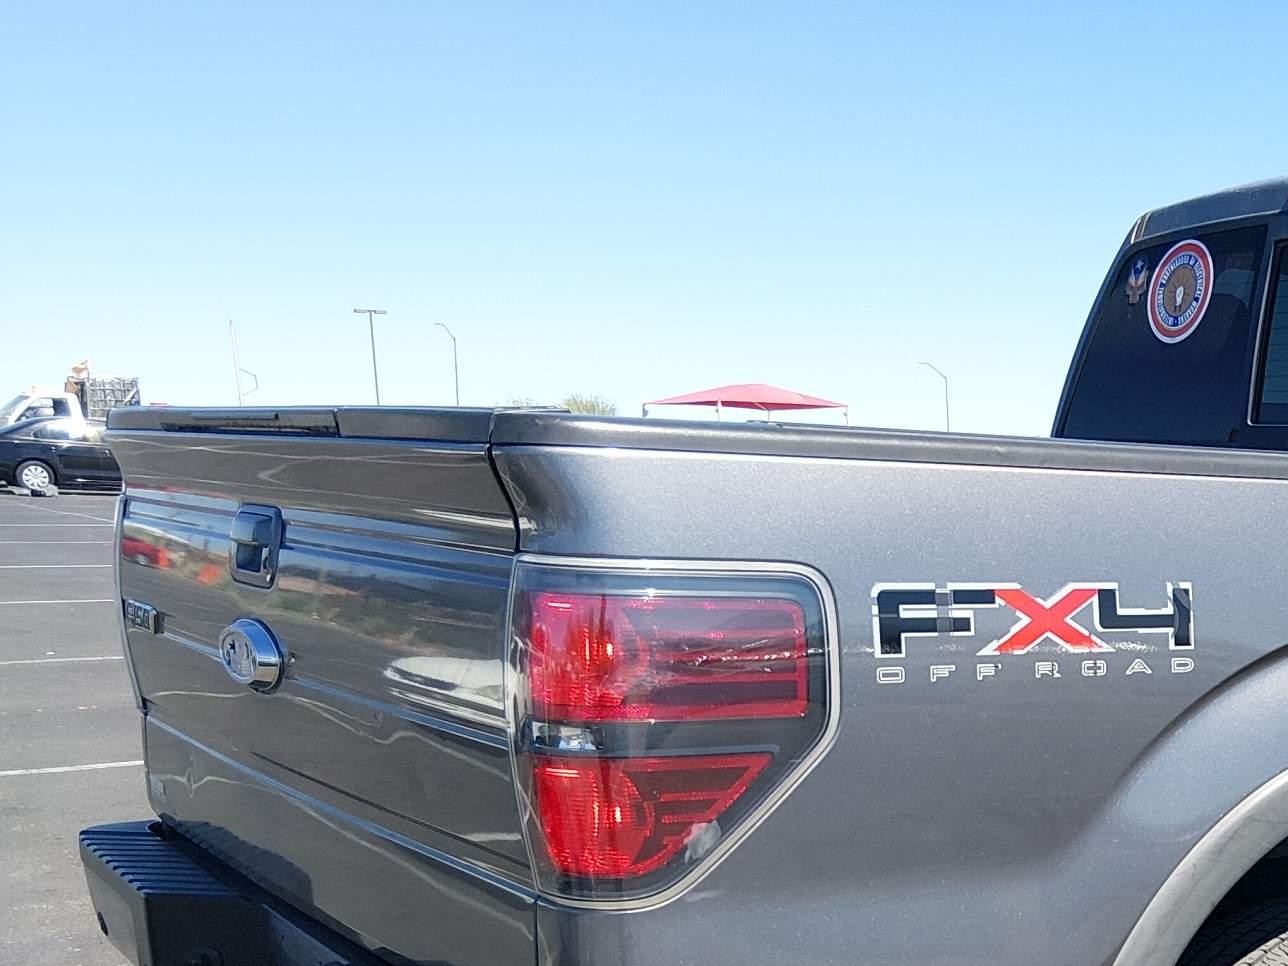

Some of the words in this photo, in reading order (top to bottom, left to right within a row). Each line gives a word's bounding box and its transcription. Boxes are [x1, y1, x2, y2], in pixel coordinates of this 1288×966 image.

[871, 581, 1195, 658] FX4
[876, 663, 1002, 684] OFF
[1034, 657, 1196, 679] ROAD
